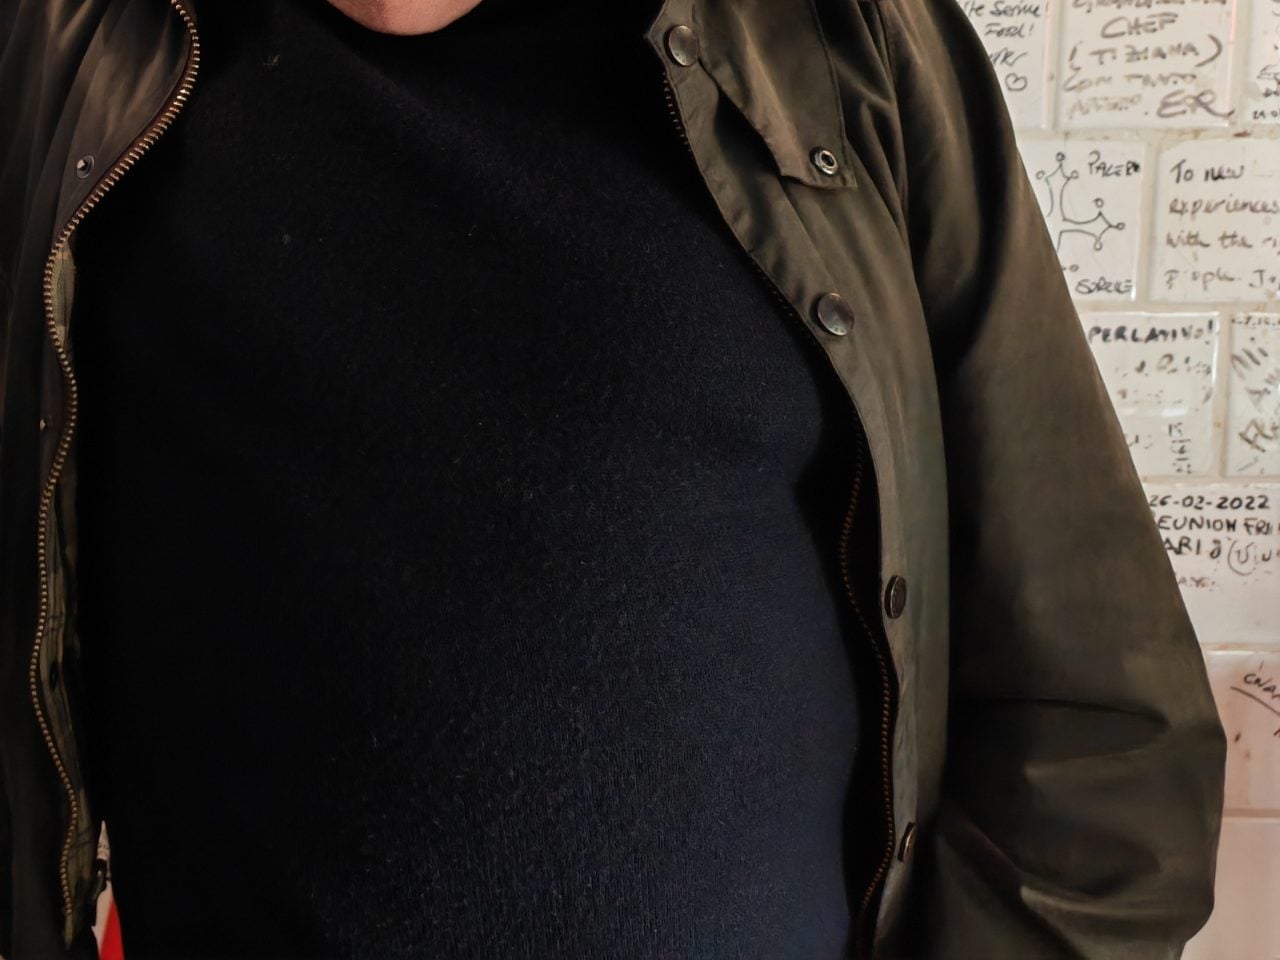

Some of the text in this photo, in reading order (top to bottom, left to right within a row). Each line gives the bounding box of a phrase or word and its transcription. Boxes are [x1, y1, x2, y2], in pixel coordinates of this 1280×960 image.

[1100, 12, 1179, 39] CHEF
[1171, 159, 1194, 183] To
[1166, 230, 1253, 249] with the
[1157, 515, 1237, 534] EUNION
